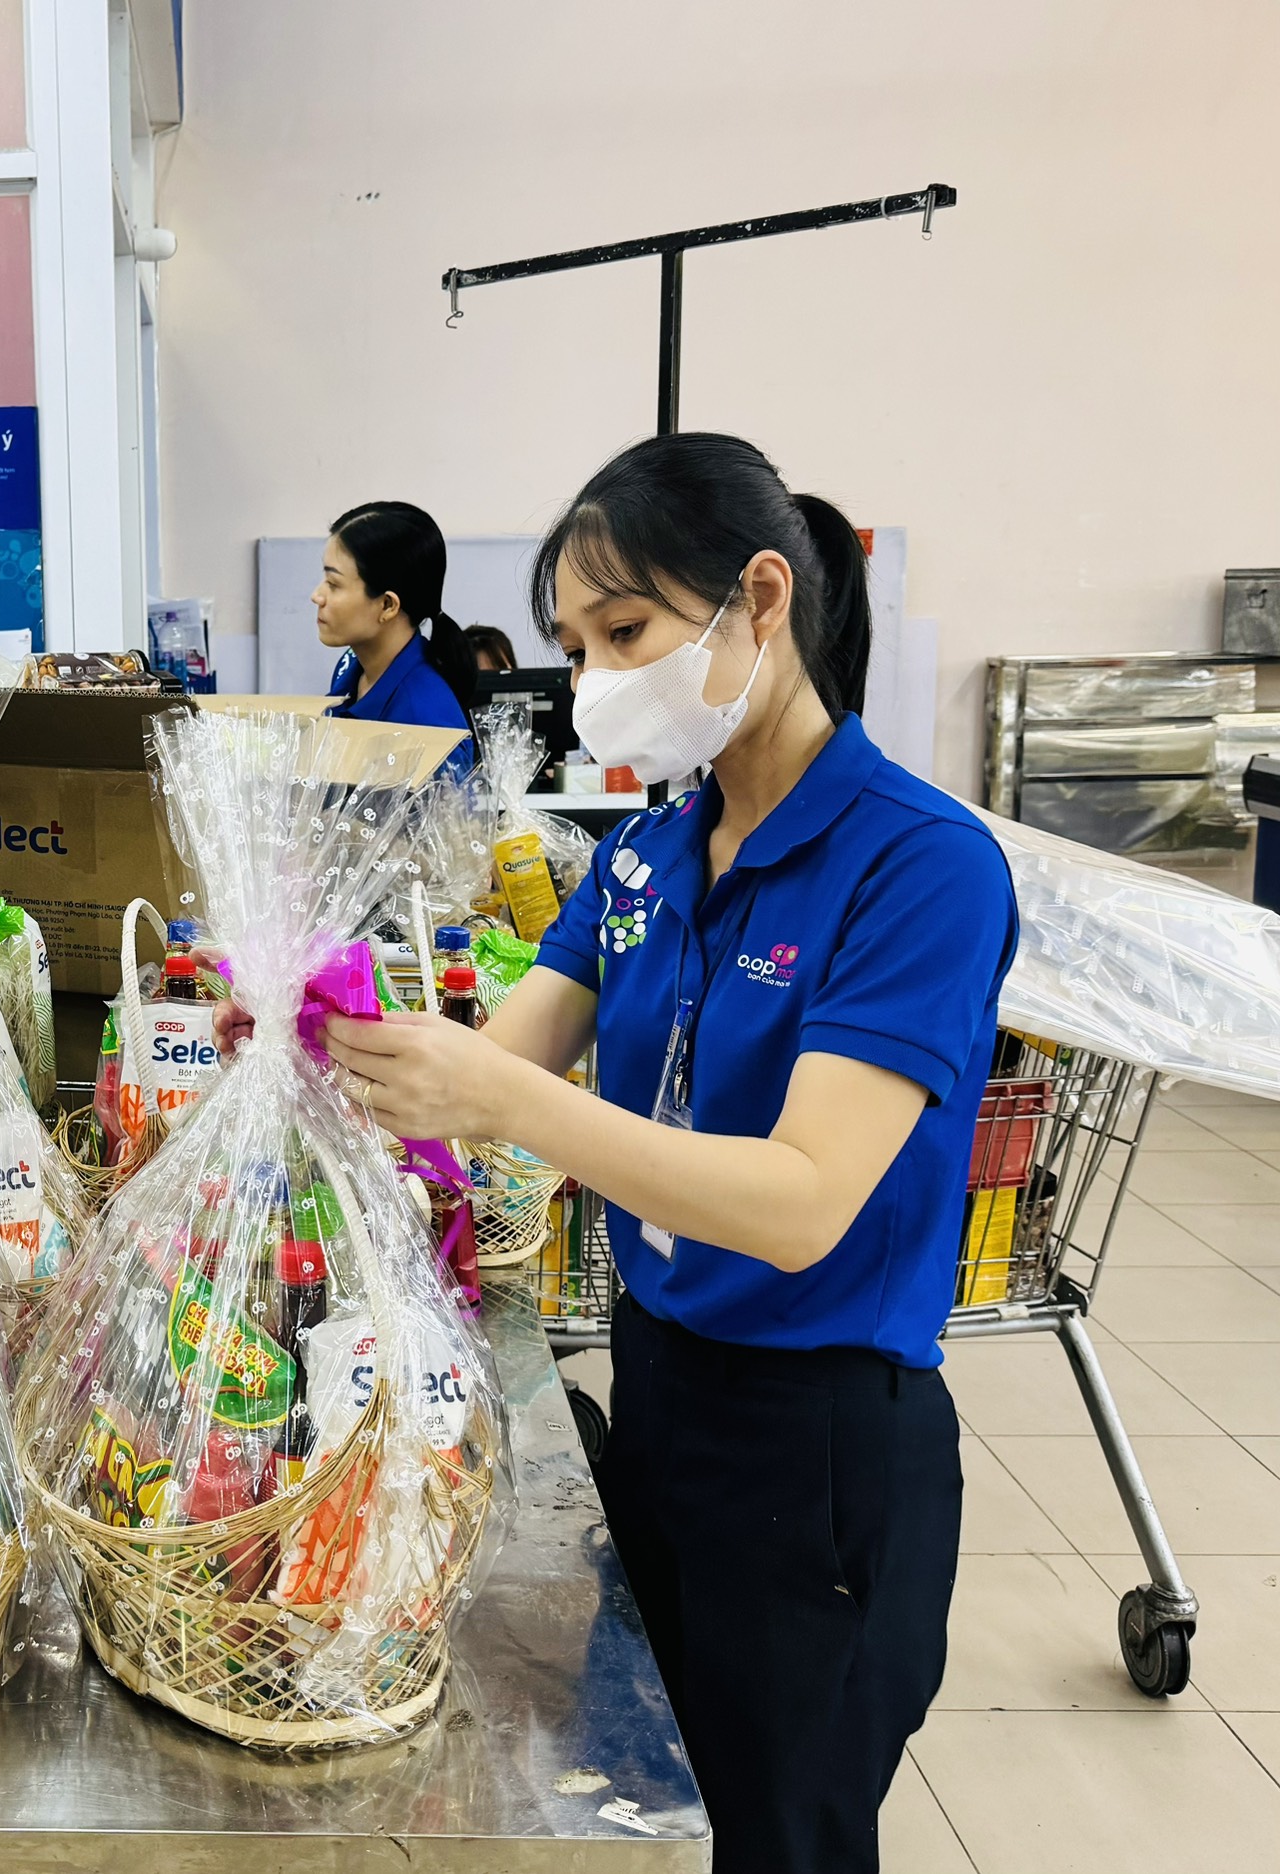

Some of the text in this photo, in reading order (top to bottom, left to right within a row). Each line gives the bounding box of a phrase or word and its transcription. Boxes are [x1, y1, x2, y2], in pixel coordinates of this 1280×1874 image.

[2, 429, 13, 452] ý
[155, 1022, 184, 1032] COOP
[152, 1036, 220, 1066] Sele
